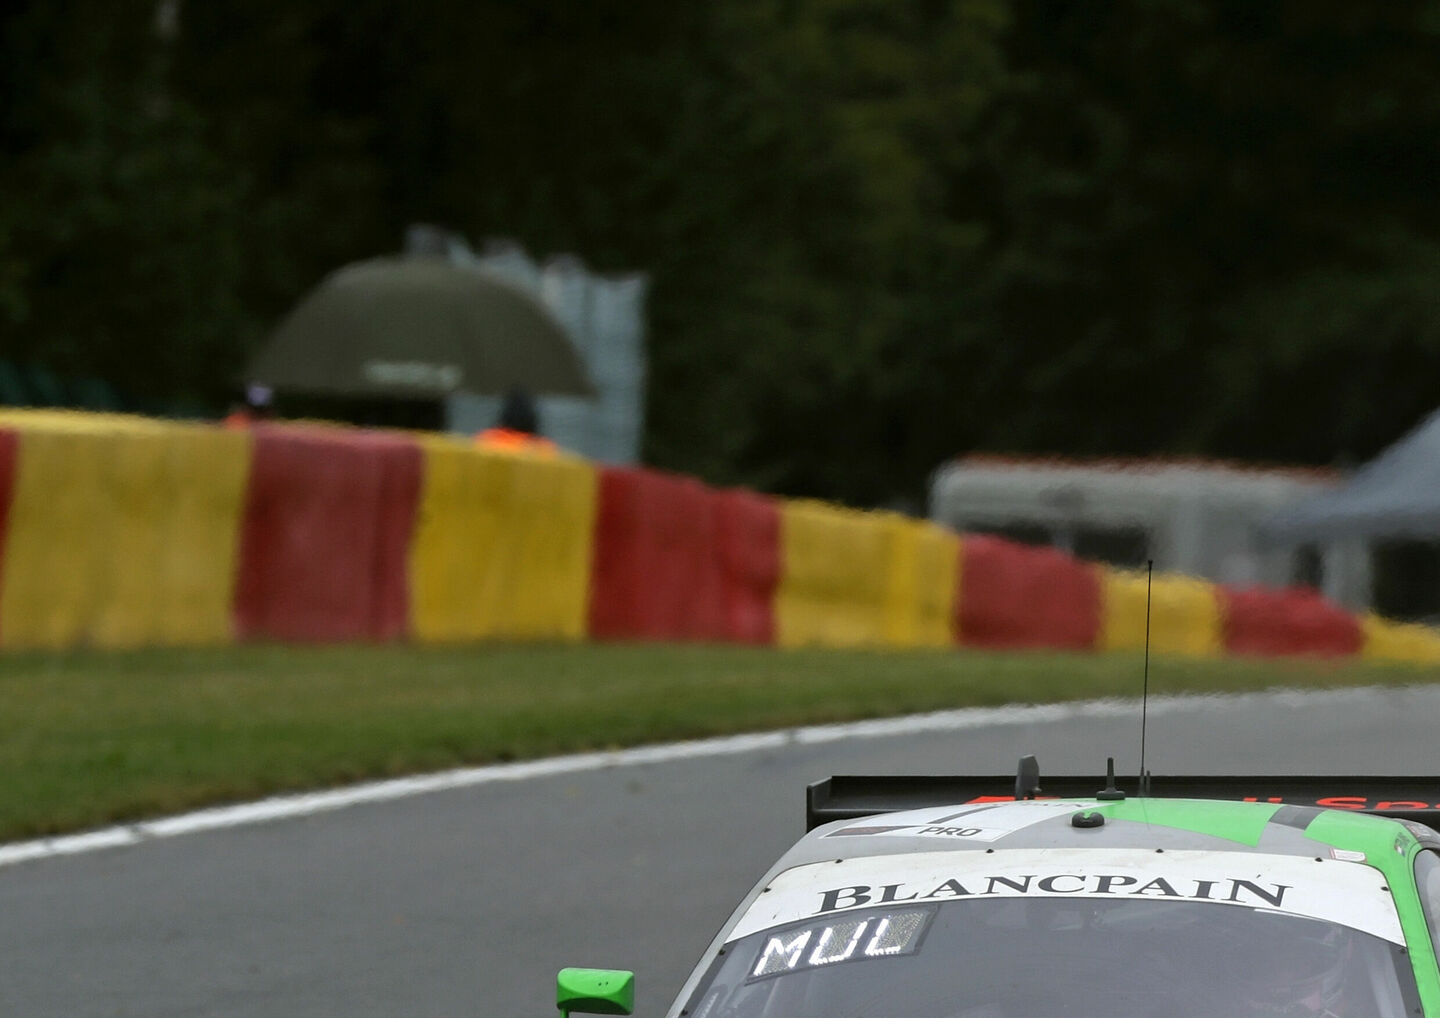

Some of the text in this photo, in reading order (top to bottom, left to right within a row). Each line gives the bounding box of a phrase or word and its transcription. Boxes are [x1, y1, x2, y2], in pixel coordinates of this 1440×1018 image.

[917, 826, 983, 838] PRO
[812, 875, 1294, 914] BLANCPAIN
[754, 916, 902, 977] MUL
